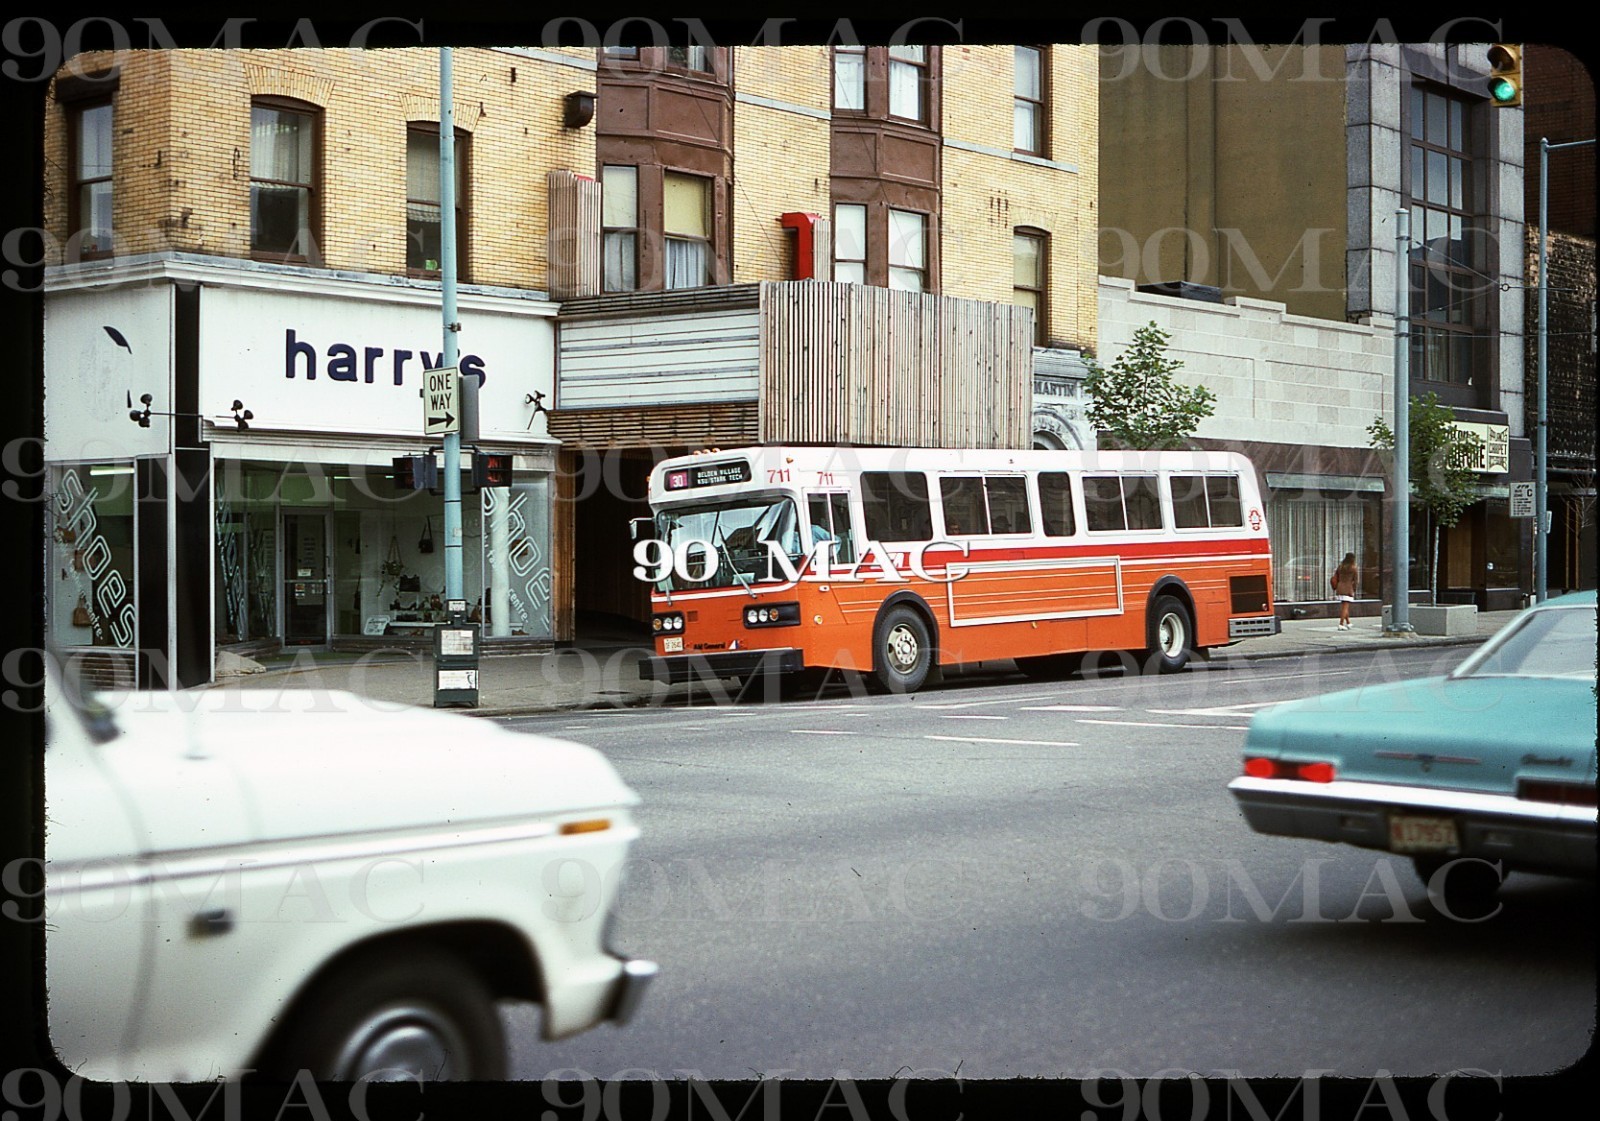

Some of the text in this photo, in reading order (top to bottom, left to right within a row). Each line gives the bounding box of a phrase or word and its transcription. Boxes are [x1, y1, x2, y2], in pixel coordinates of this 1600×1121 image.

[286, 329, 486, 388] harrs
[430, 373, 451, 391] ONE
[431, 393, 452, 411] WAY
[697, 467, 741, 478] BELDEN VILLAGE
[729, 473, 743, 481] TECH
[767, 468, 790, 483] 711
[817, 471, 834, 486] 711
[672, 475, 683, 488] 30
[57, 469, 136, 648] shoes
[483, 486, 549, 632] hoe
